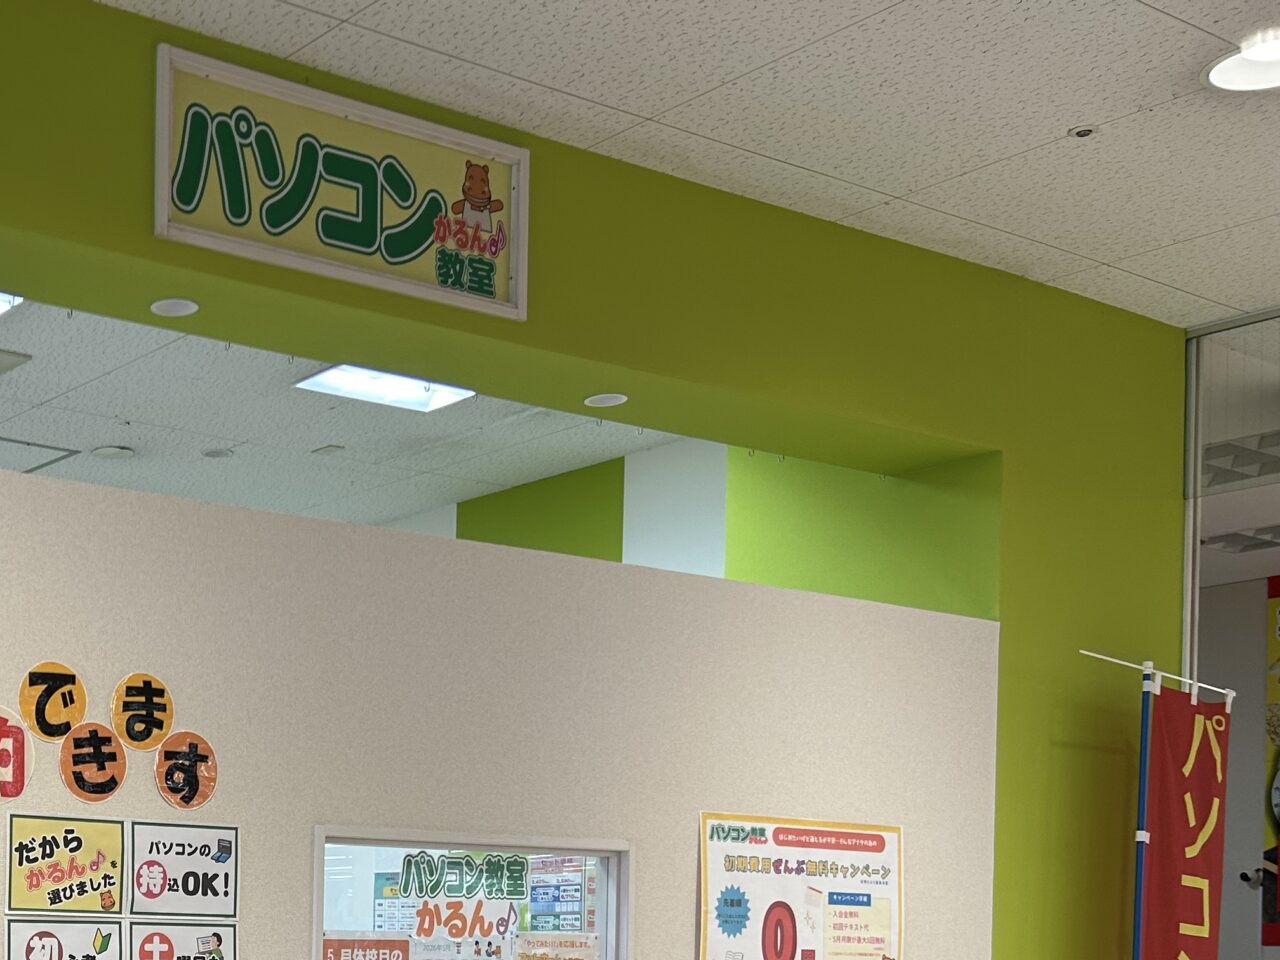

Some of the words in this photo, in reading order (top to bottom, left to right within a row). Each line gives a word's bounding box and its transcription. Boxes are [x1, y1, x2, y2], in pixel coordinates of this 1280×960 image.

[172, 103, 447, 265] パソコン
[432, 214, 488, 257] かるん
[435, 245, 496, 299] 教室
[14, 829, 83, 866] だから
[148, 841, 211, 856] パソコンの
[25, 856, 87, 891] かるん
[400, 852, 529, 900] パソコン教室
[724, 854, 891, 880] 初期費用ぜんぶ無料キャンペーン
[47, 874, 116, 906] 選びました
[415, 899, 494, 938] かるん
